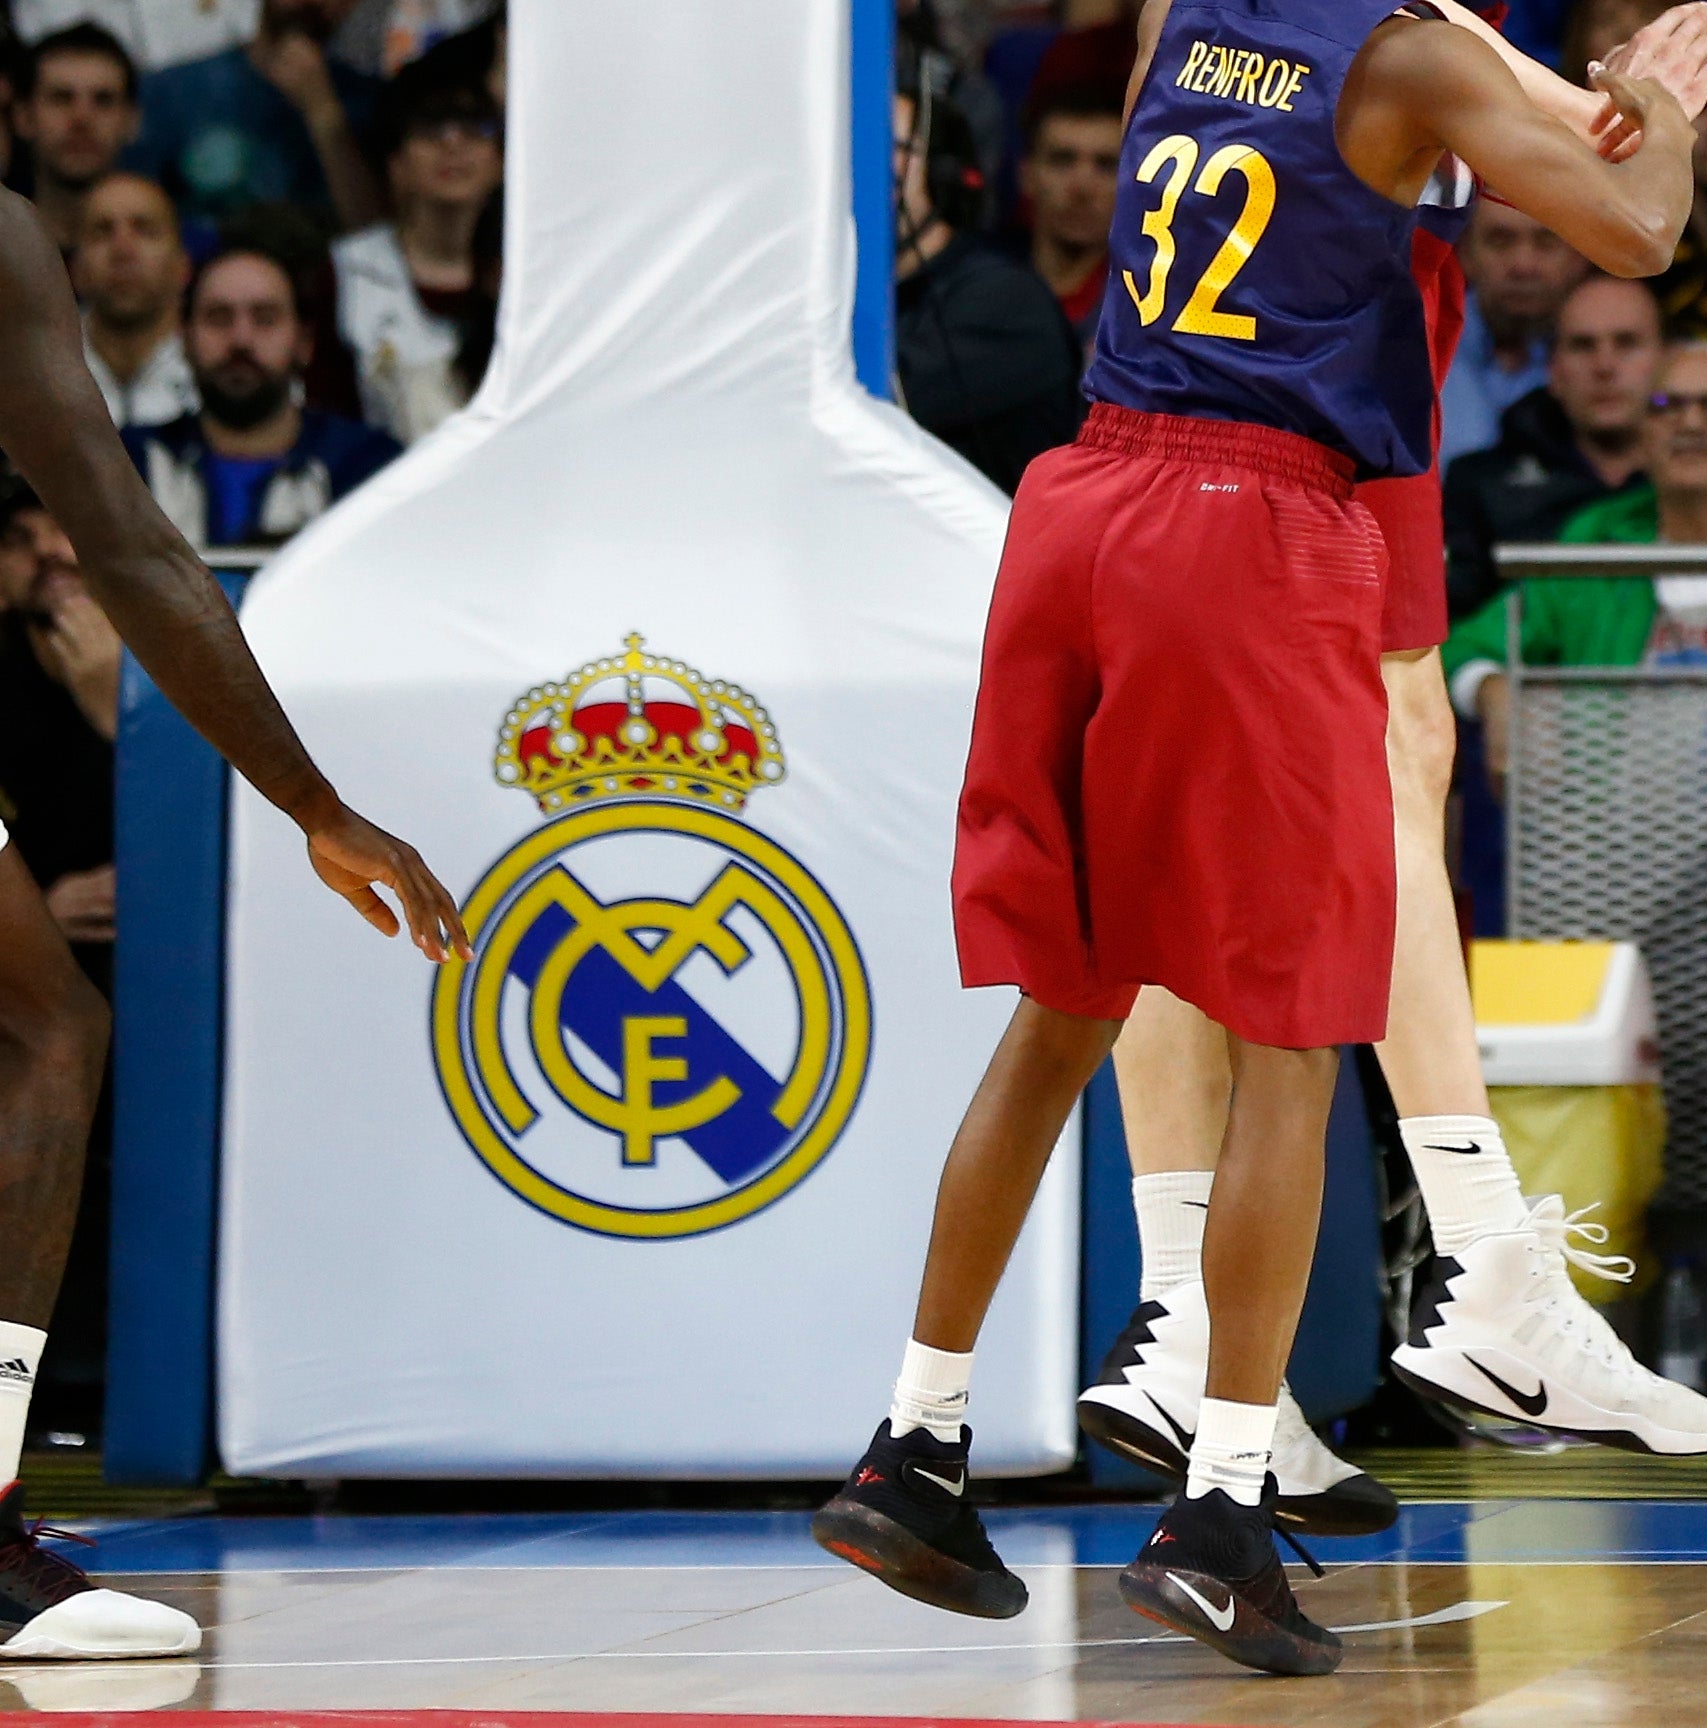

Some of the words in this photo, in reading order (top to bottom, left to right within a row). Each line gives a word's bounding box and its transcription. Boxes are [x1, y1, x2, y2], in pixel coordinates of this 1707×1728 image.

[1174, 39, 1311, 113] RENFROE
[1121, 133, 1278, 341] 32
[0, 1370, 34, 1384] didas
